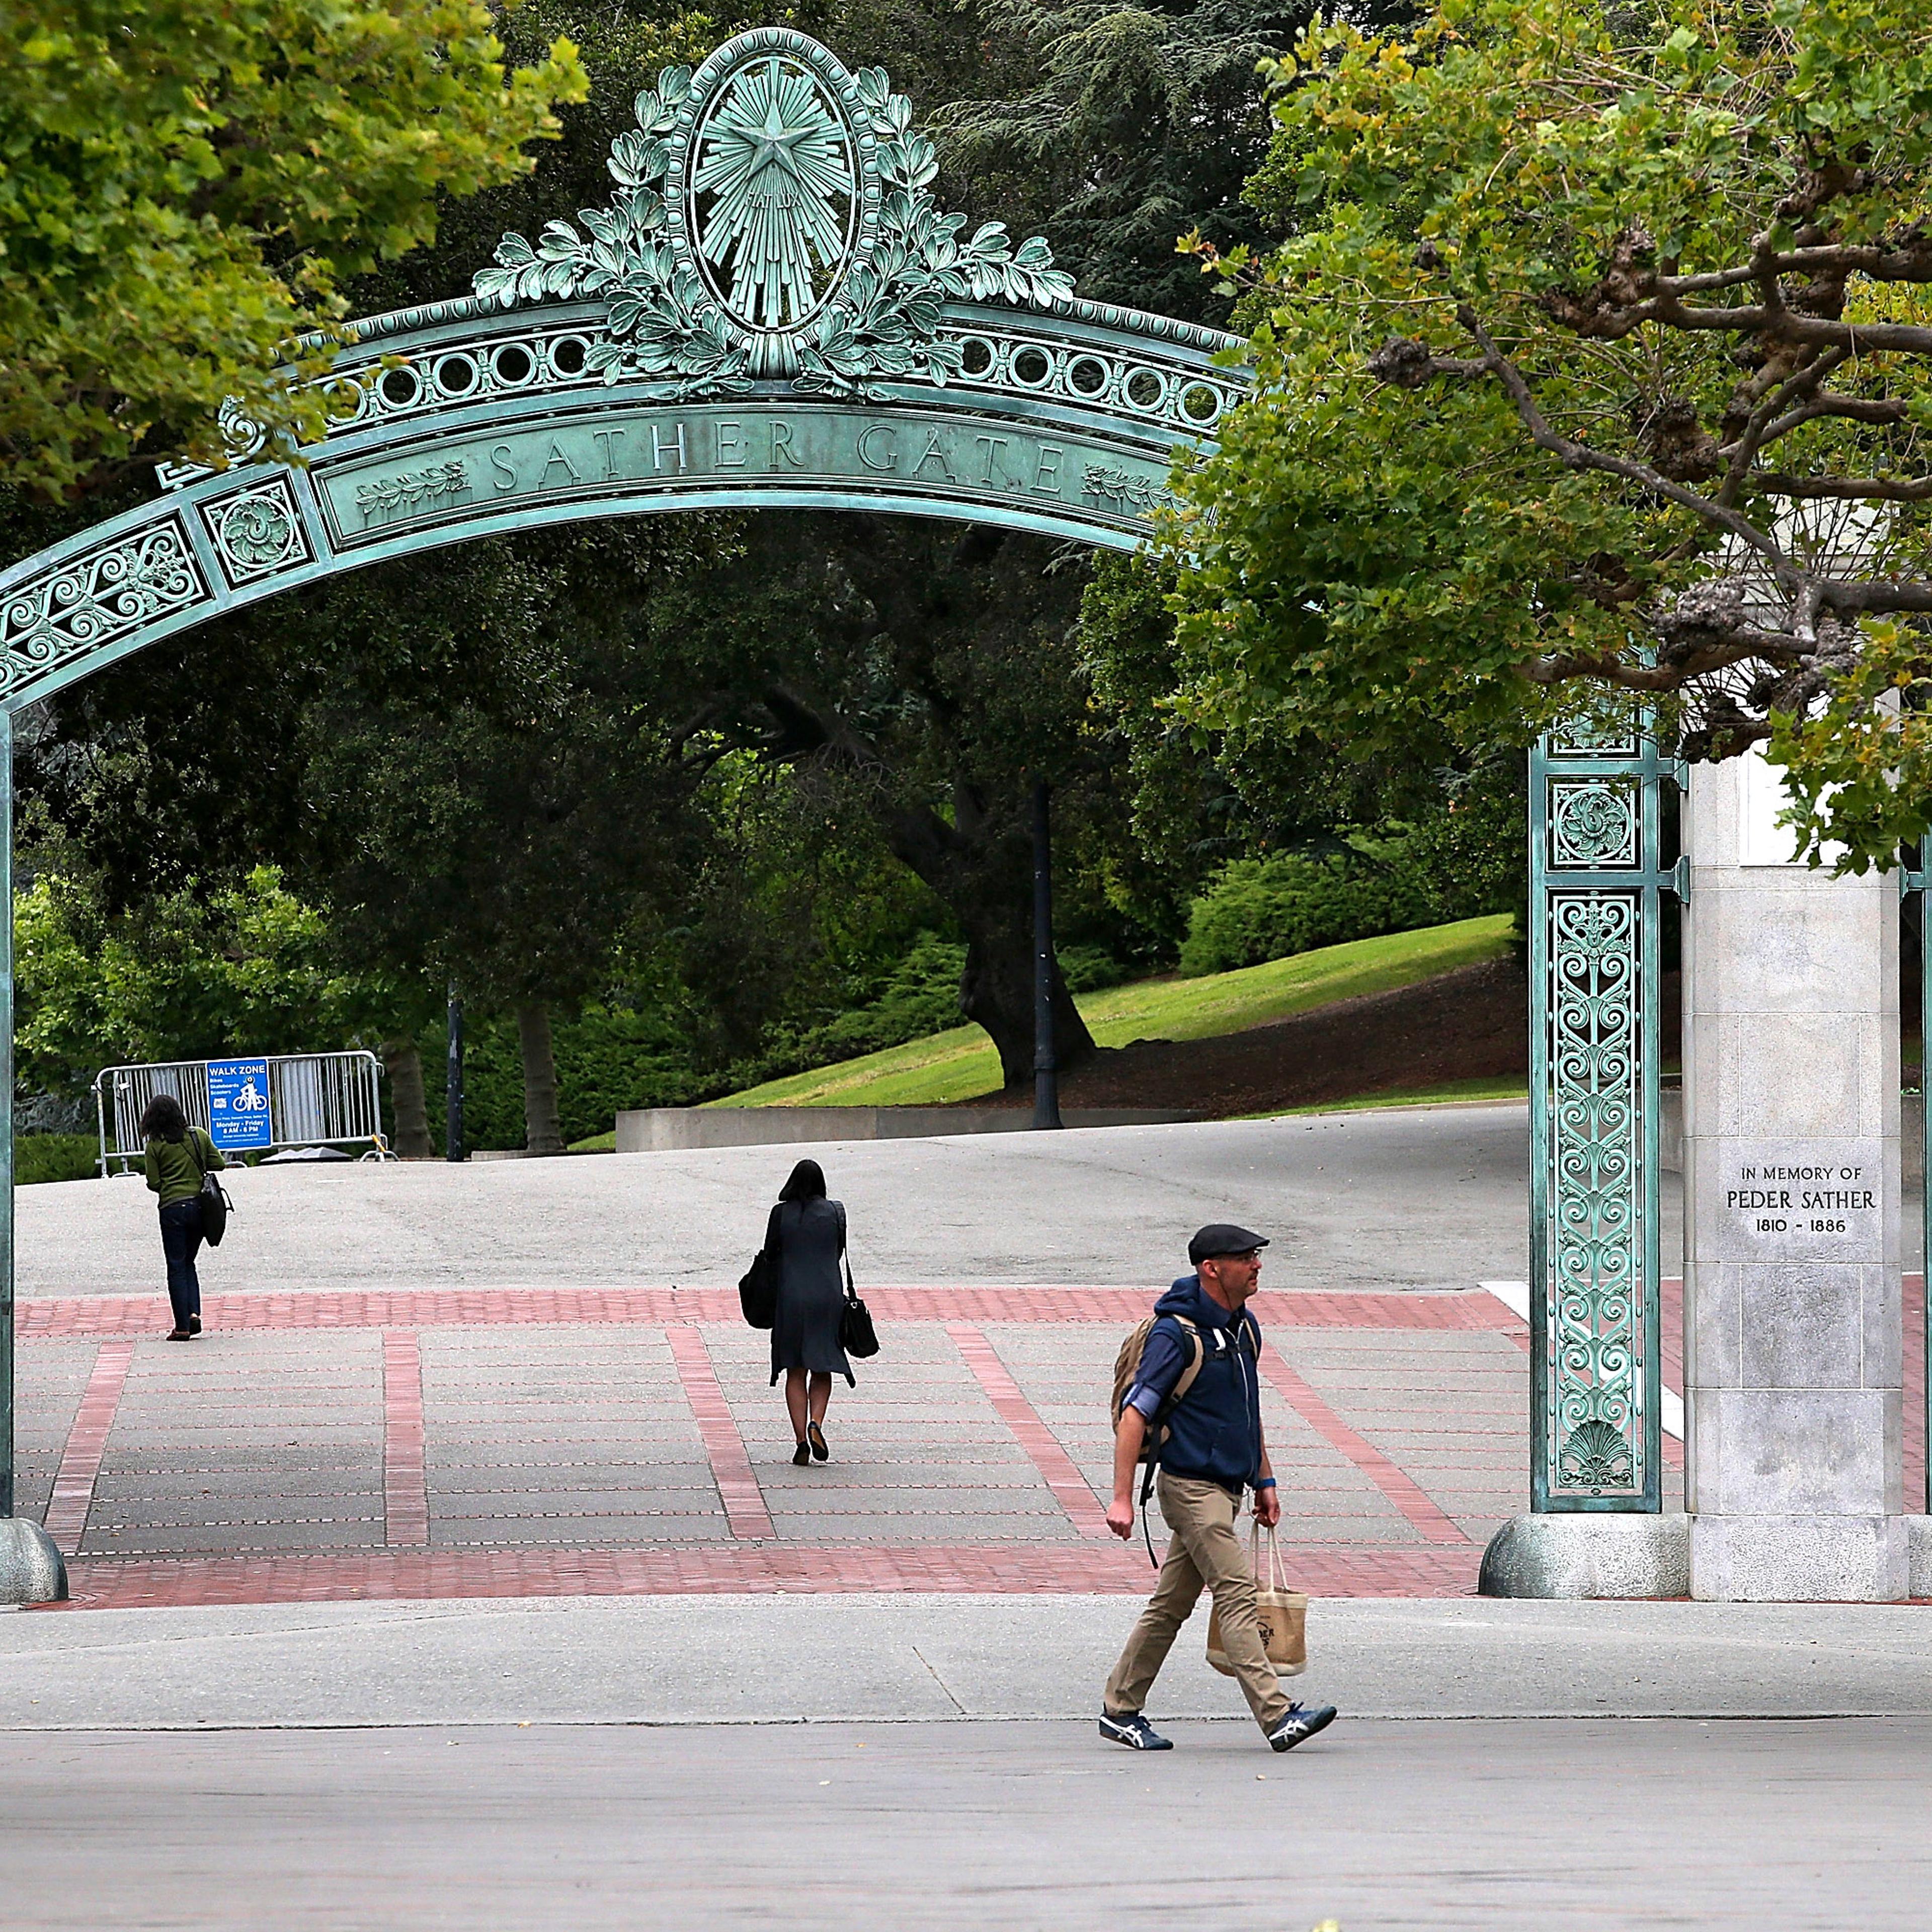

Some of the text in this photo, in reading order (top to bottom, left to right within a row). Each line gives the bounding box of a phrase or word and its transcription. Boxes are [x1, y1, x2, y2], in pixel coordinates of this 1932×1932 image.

[745, 191, 801, 208] FIAT LUX
[490, 420, 1064, 493] SATHER GATE
[209, 1065, 265, 1076] WALK ZONE
[1741, 1167, 1861, 1180] IN MEMORY OF
[1727, 1190, 1876, 1209] PEDER SATHER
[1757, 1219, 1787, 1232] 1810
[1811, 1220, 1846, 1232] 1886
